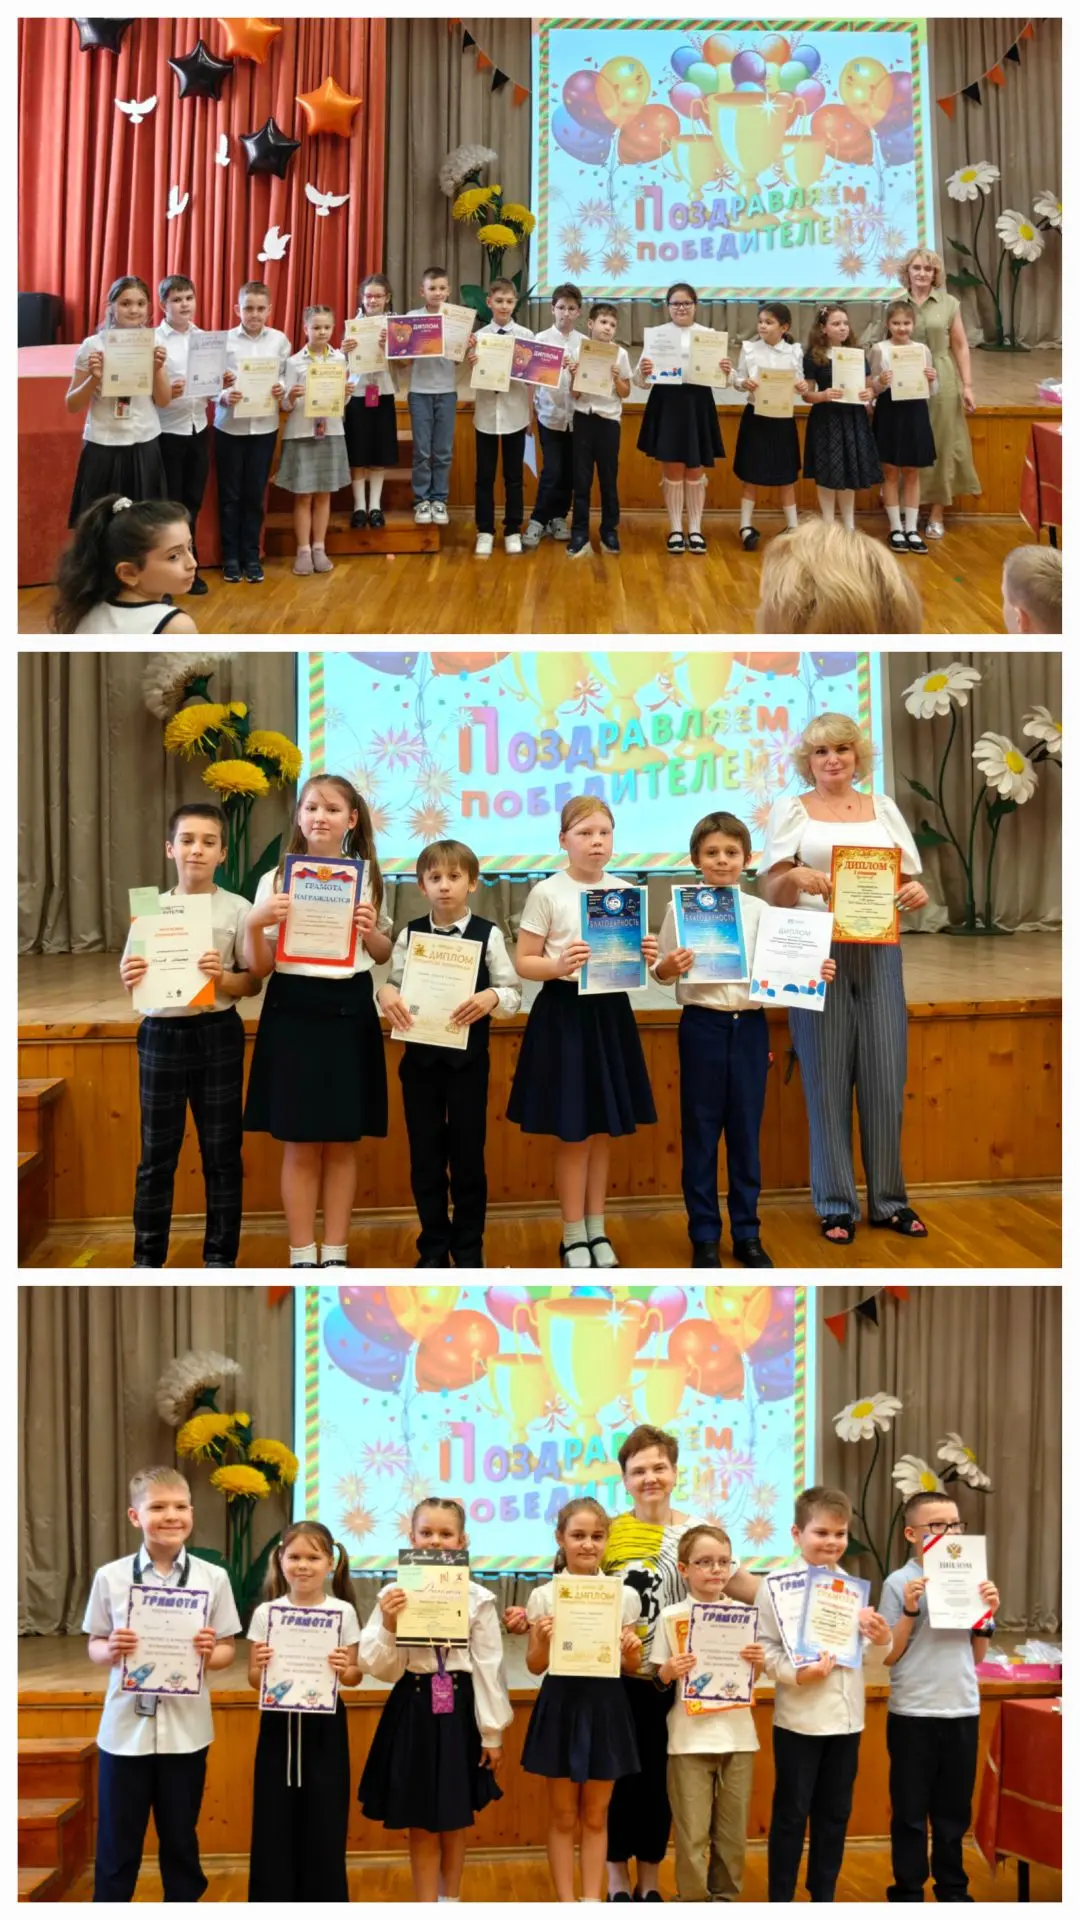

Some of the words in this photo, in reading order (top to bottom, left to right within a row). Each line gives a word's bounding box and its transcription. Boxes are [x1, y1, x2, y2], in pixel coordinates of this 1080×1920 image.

[844, 861, 887, 871] ДИПЛОМ
[304, 882, 343, 892] ГРАМОТА
[590, 918, 639, 928] БЛАГОДАРНОСТЬ
[684, 914, 735, 923] БЛАГОДАРНОСТЬ
[778, 927, 811, 937] ДИПЛОМ
[428, 950, 474, 965] ДИПЛОМ
[780, 1578, 805, 1592] ГРАМ
[574, 1590, 615, 1600] ДИПЛОМ
[142, 1595, 199, 1609] ГРАМОТА
[280, 1614, 333, 1628] ГРАМОТА
[702, 1612, 751, 1624] ГРАМОТА
